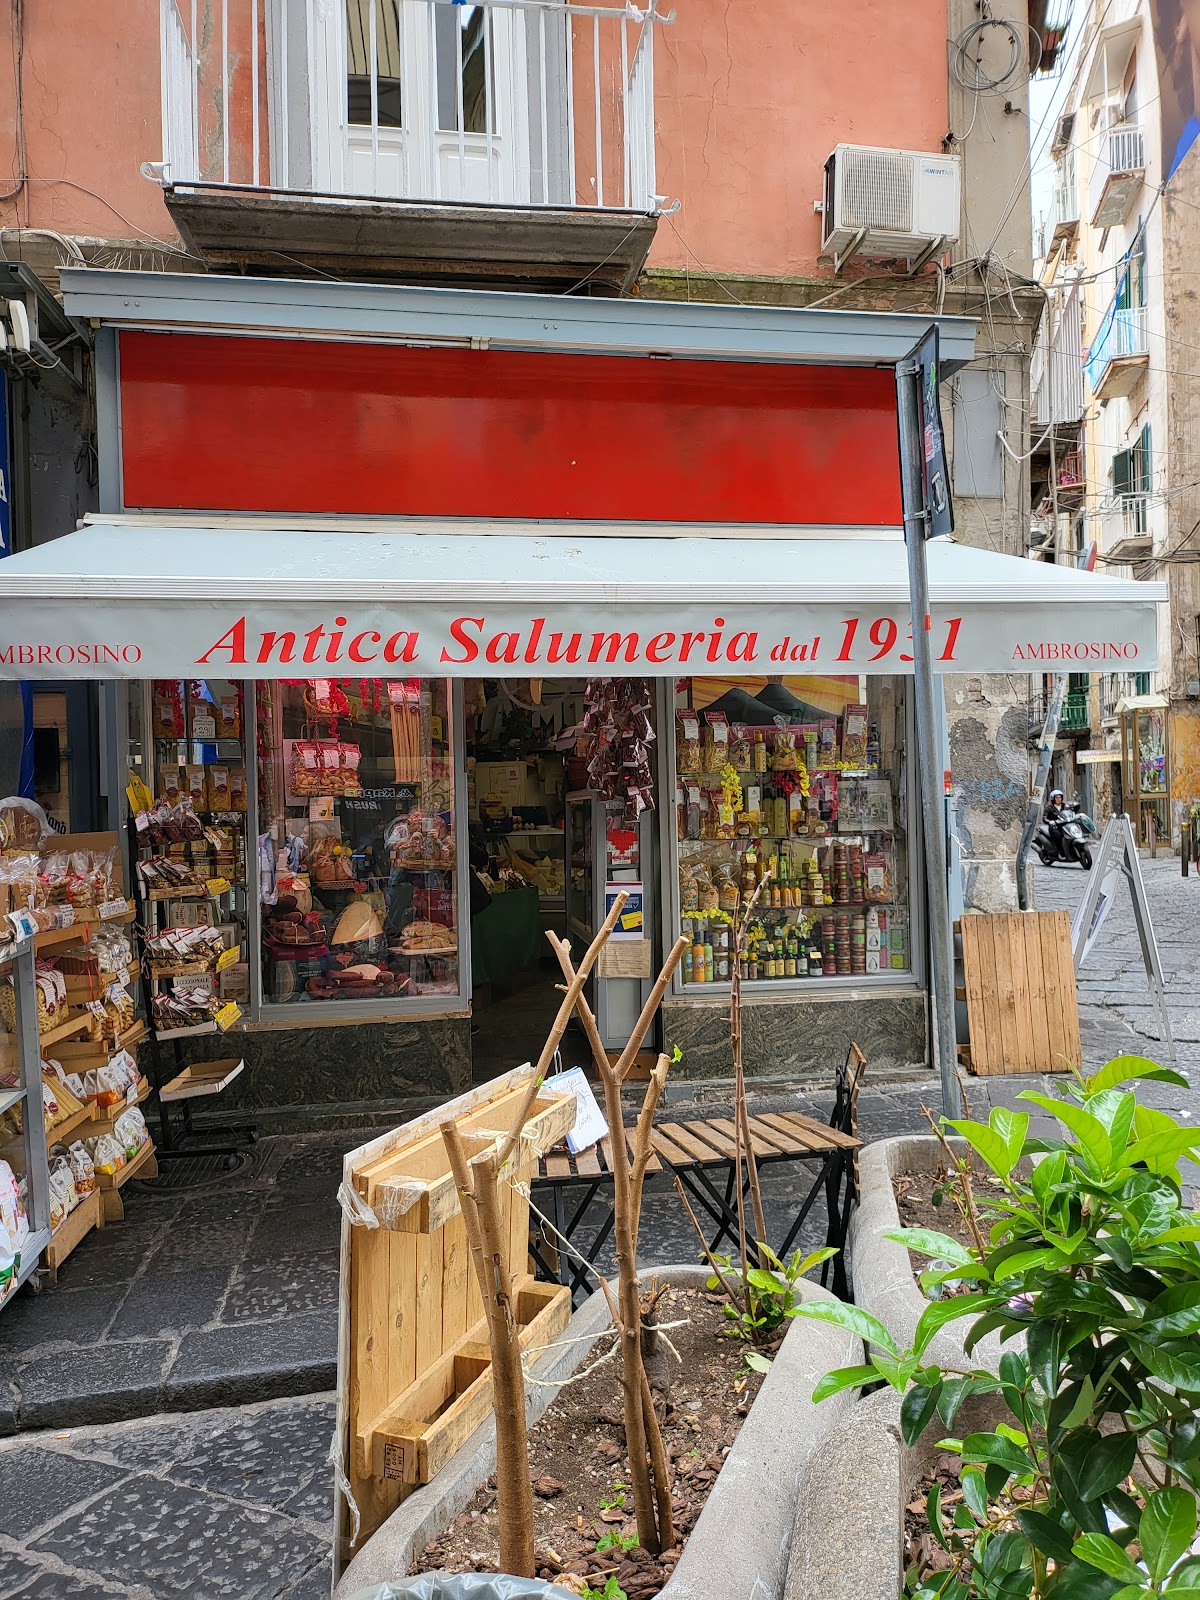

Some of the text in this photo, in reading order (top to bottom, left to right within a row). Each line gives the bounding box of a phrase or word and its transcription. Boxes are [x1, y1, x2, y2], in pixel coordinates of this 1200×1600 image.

[194, 615, 420, 664] Antica
[440, 616, 759, 664] Salumeria
[770, 636, 821, 662] dal
[1011, 641, 1139, 660] AMBROSINO
